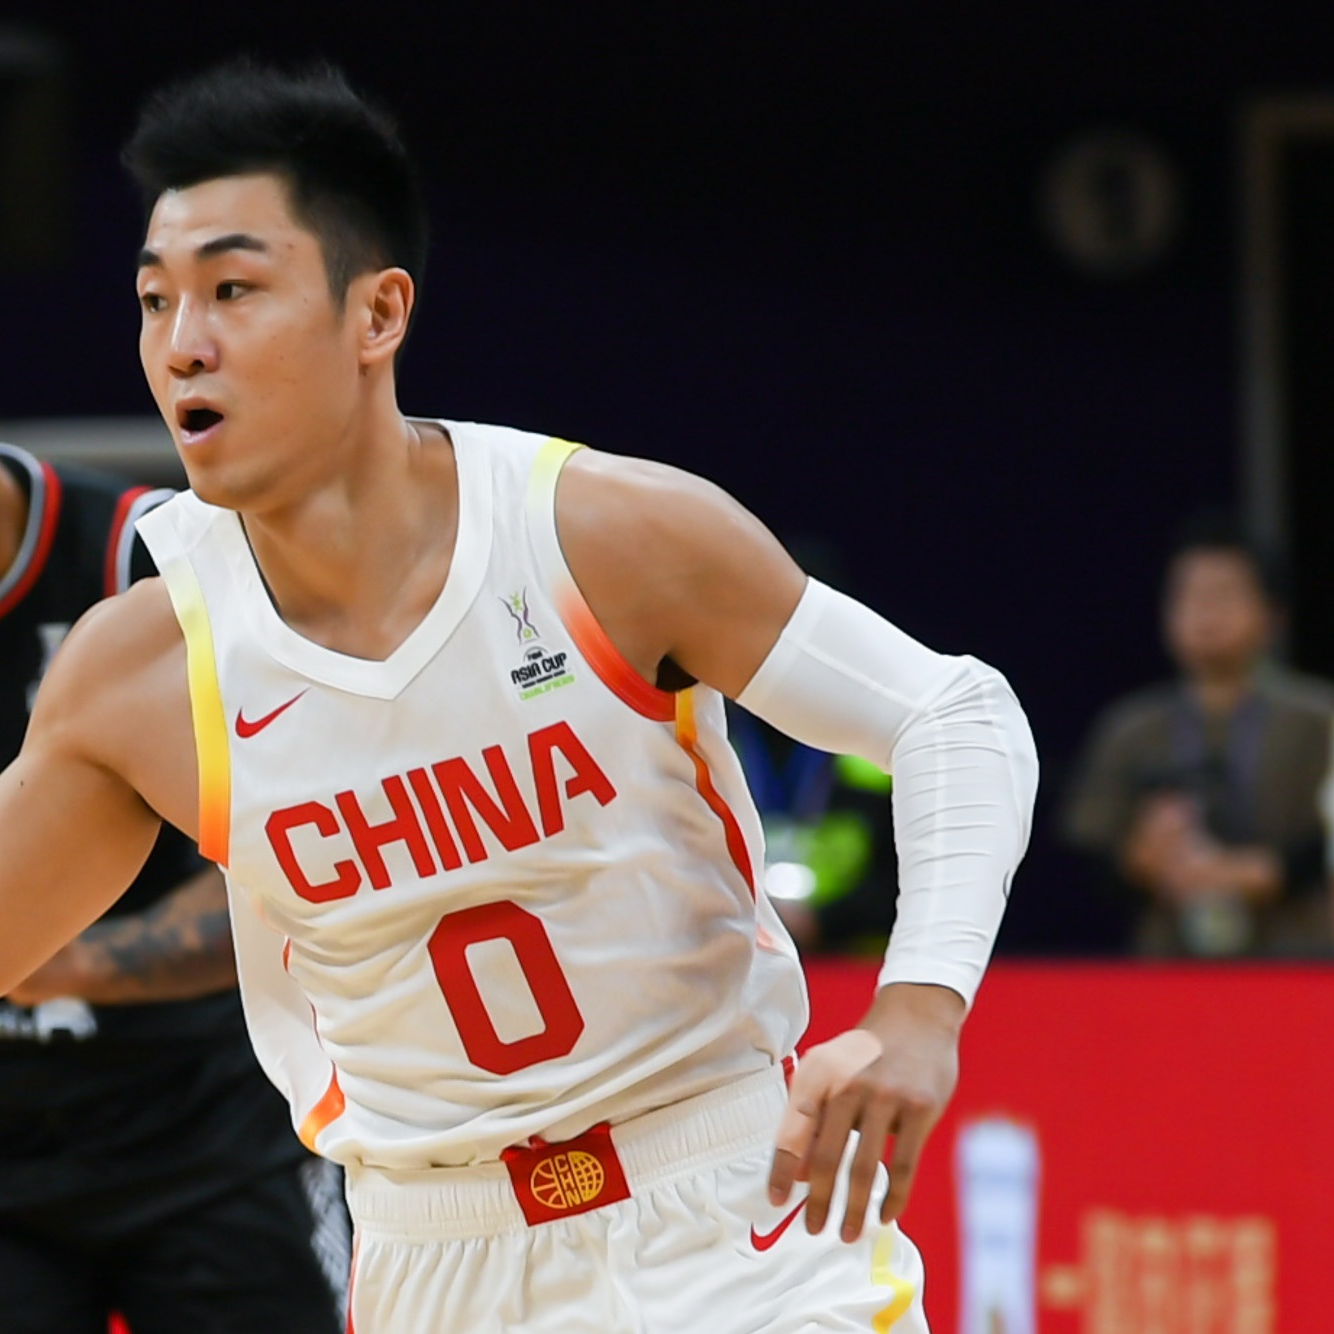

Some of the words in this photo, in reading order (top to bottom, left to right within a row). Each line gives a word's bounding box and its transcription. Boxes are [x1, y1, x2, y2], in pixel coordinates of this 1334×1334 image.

[511, 663, 541, 684] ASIA
[542, 653, 566, 672] CUP
[264, 720, 617, 904] CHINA
[427, 900, 585, 1075] 0
[554, 1153, 582, 1207] CHN
